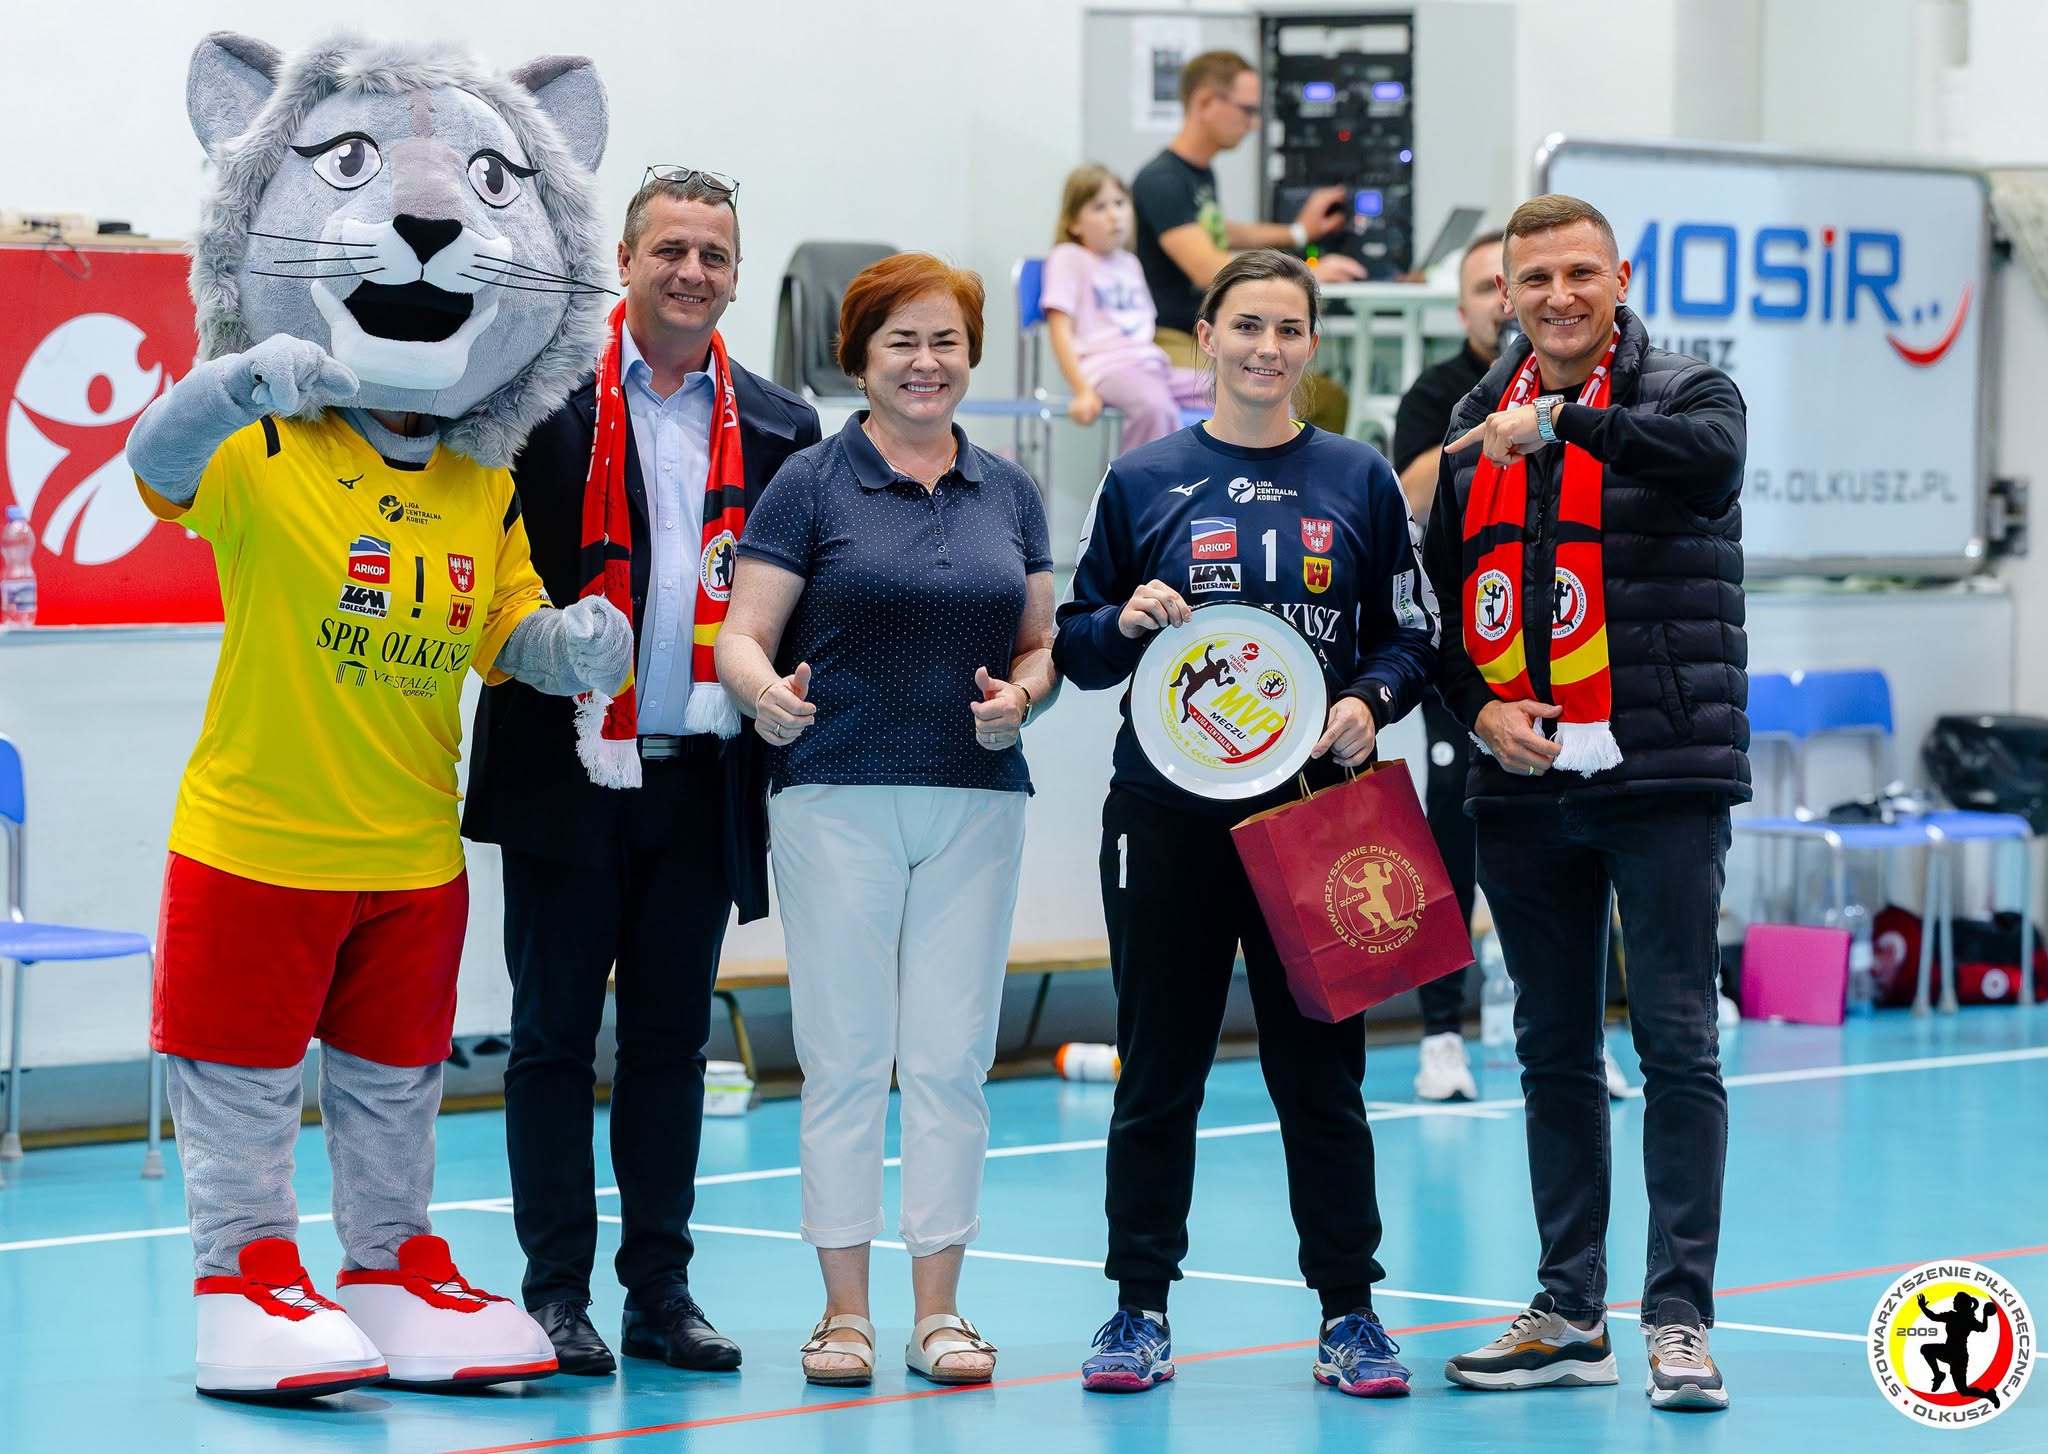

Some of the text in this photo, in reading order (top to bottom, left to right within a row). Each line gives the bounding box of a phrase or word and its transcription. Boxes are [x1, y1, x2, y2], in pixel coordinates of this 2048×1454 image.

[1256, 488, 1298, 497] CENTRALNA
[1256, 494, 1282, 502] KOBIET
[1754, 468, 1957, 504] R.OLKUSZ.PL
[404, 501, 420, 510] LIGA
[405, 509, 442, 521] CENTRALNA
[406, 516, 429, 525] KOBIET
[1198, 542, 1232, 553] ARKOP
[1262, 529, 1277, 582] 1
[353, 563, 386, 576] ARKOP
[1191, 565, 1237, 583] ZGM
[340, 585, 386, 609] ZGM
[1191, 582, 1232, 591] BOLESŁAW
[338, 602, 380, 617] BOLESŁAW
[1261, 603, 1341, 643] KUSZ
[317, 618, 370, 656] SPR
[382, 631, 472, 674] OLKUSZ
[1210, 683, 1286, 736] MVP
[1196, 714, 1208, 728] LIGA
[1206, 725, 1233, 751] CENTRALNA
[1209, 711, 1246, 740] MECZU
[1118, 833, 1128, 889] 1
[1324, 845, 1426, 948] STOWARZYSZENIE PIŁKI RĘCZNEJ
[1339, 891, 1365, 908] 2009
[1367, 927, 1415, 954] OLKUSZ
